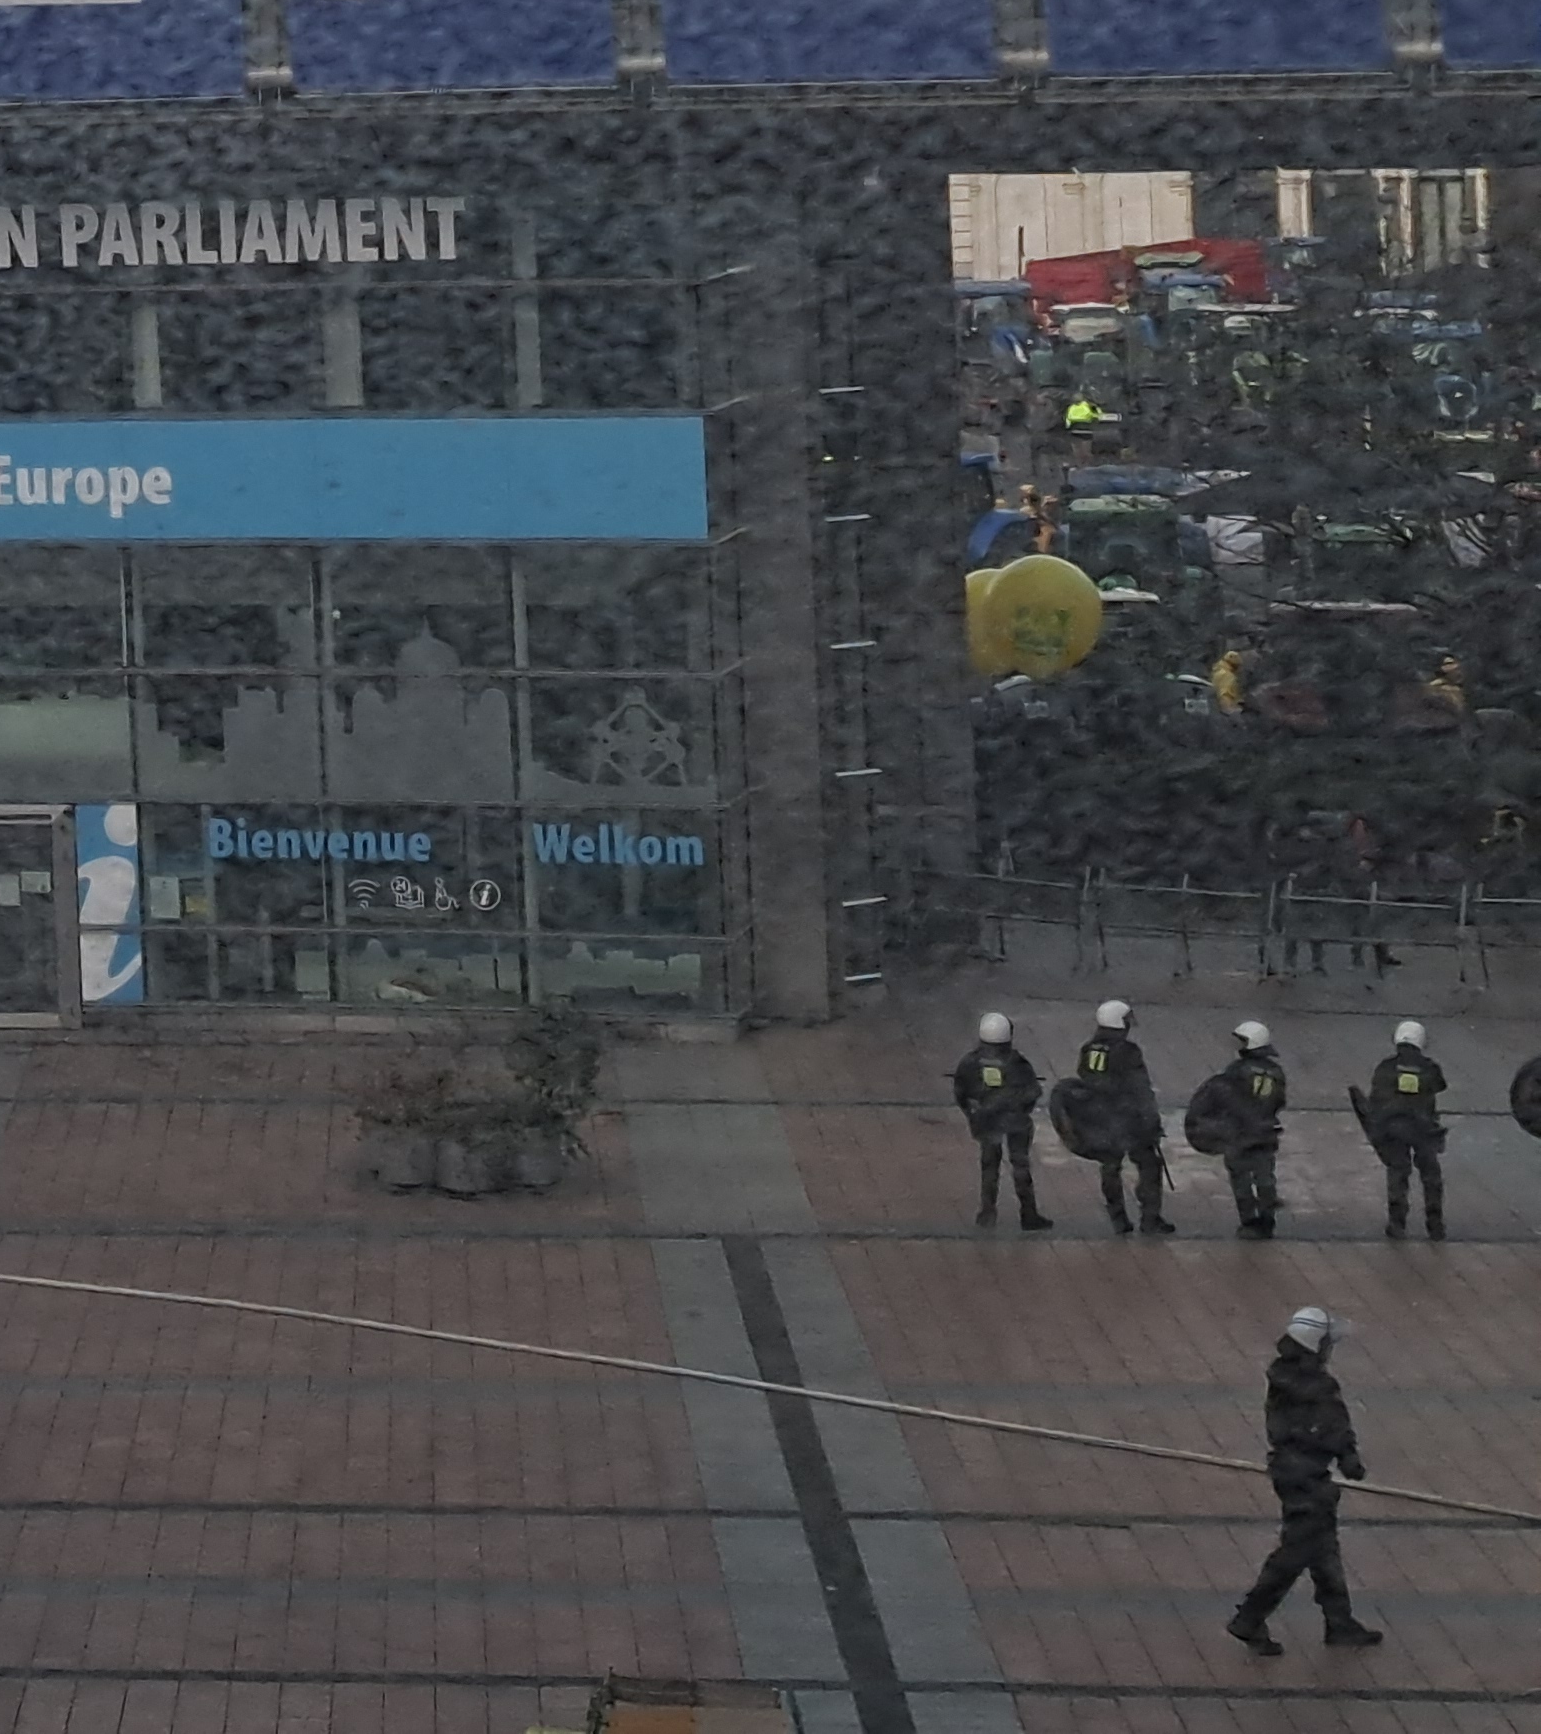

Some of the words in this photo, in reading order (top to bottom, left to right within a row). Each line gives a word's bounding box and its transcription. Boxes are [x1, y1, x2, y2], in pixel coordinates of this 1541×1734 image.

[59, 196, 466, 267] PARLIAMENT
[208, 817, 432, 864] Bienvenue
[532, 821, 704, 866] Welkom
